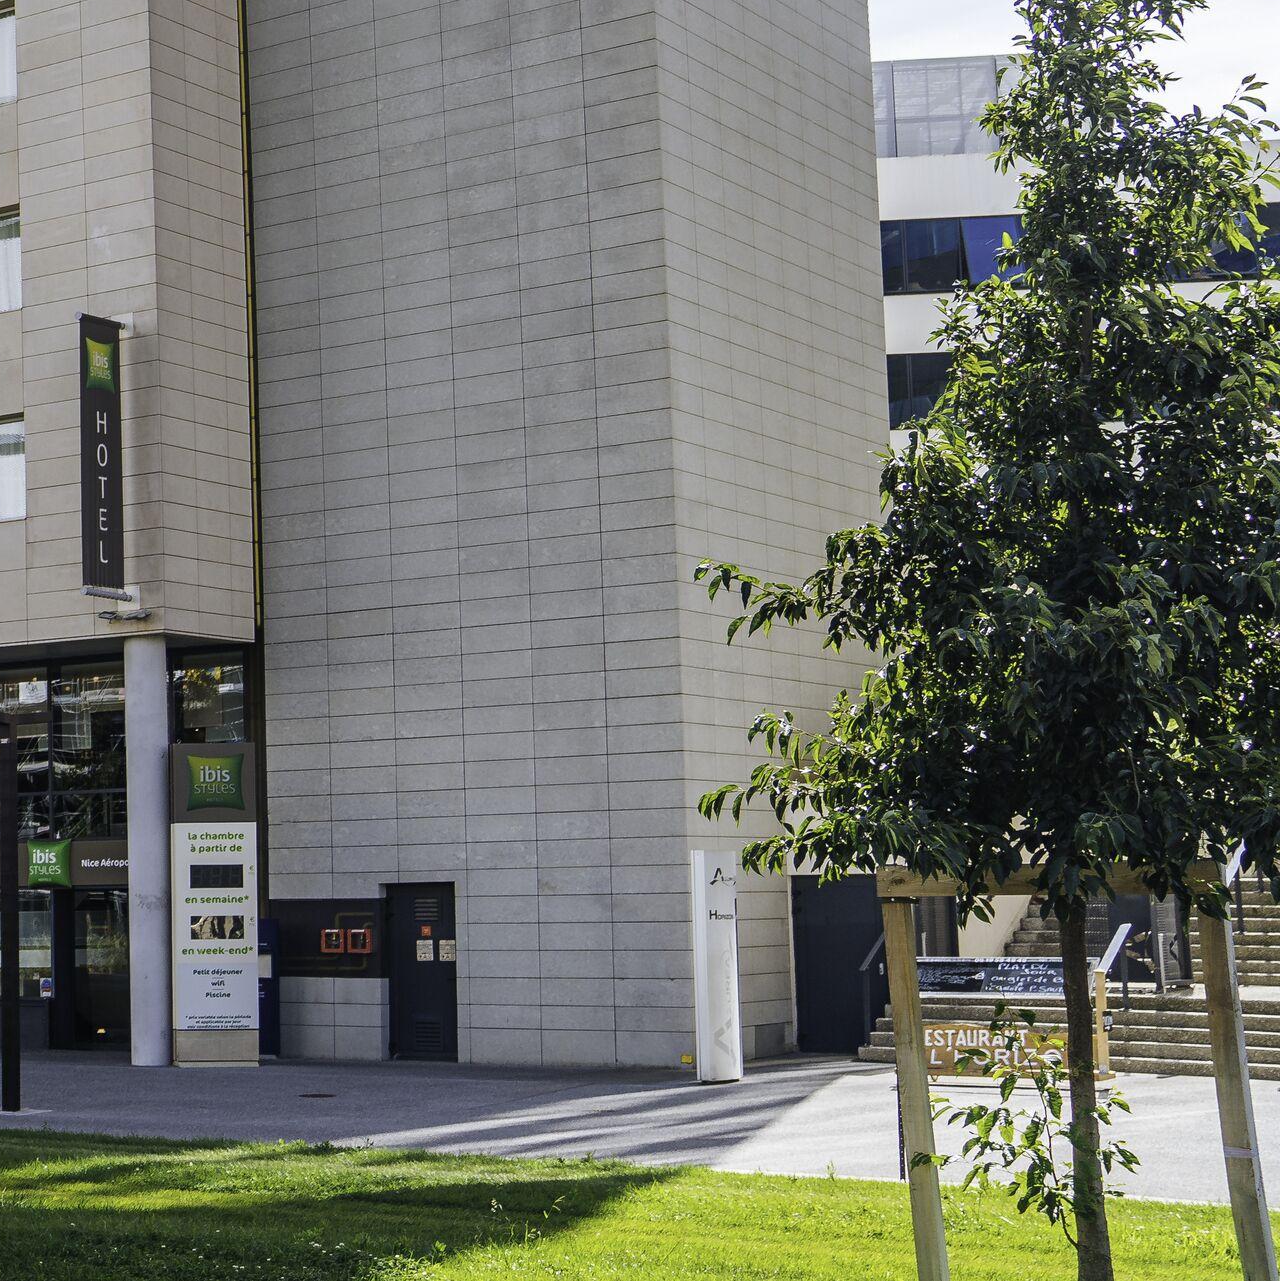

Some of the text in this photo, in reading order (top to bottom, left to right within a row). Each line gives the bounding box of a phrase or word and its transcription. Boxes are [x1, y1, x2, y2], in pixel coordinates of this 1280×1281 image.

[92, 351, 108, 368] ibis
[96, 410, 108, 564] HOTEL
[200, 765, 231, 782] ibis
[188, 832, 244, 840] la chambre
[190, 844, 242, 854] à partir de
[32, 849, 57, 864] ibis
[81, 858, 129, 869] Nice Aéropo
[211, 968, 243, 976] déjeuner
